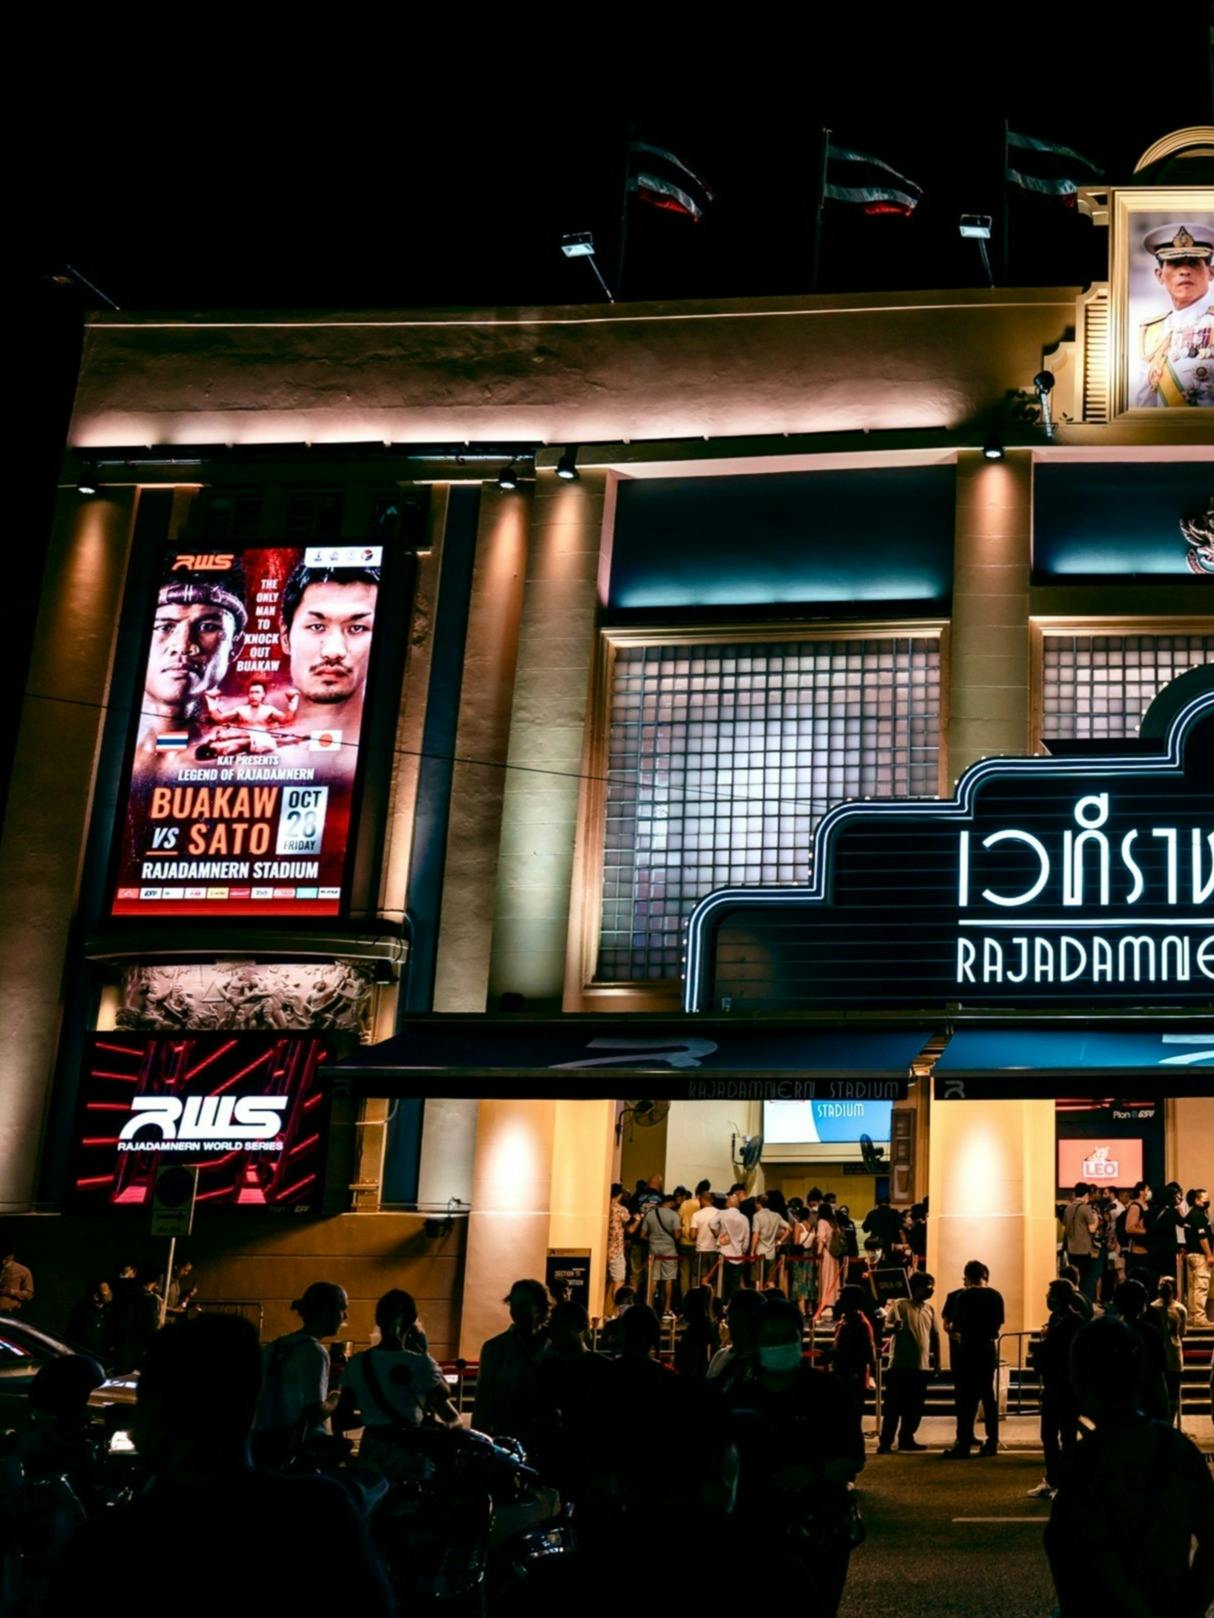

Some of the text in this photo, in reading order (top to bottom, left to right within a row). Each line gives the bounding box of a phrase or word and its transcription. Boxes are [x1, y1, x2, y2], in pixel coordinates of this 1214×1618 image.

[172, 554, 234, 571] RWS
[261, 579, 278, 589] THE
[256, 592, 279, 602] ONLY
[255, 606, 276, 616] MAN
[258, 619, 270, 630] TO
[244, 634, 279, 644] KNOCK
[250, 647, 270, 658] OUT
[236, 661, 280, 672] BUAKAW
[217, 756, 280, 766] KAT PRESENTS
[178, 768, 314, 780] LEGEND OF RAJADAMNERN
[151, 787, 278, 818] BUAKAW
[288, 791, 322, 808] OCT
[286, 811, 316, 838] 28
[152, 823, 270, 855] VS SATO
[283, 840, 316, 850] FRIDAY
[142, 862, 319, 879] RAJADAMNERN STADIUM
[688, 1080, 900, 1100] RAJADAMNERN STADIUM
[817, 1104, 864, 1118] STADIUM
[118, 1096, 288, 1140] RWS
[118, 1142, 284, 1151] RAJADAMNERN WORLD SERIES
[1084, 1162, 1117, 1176] LEO
